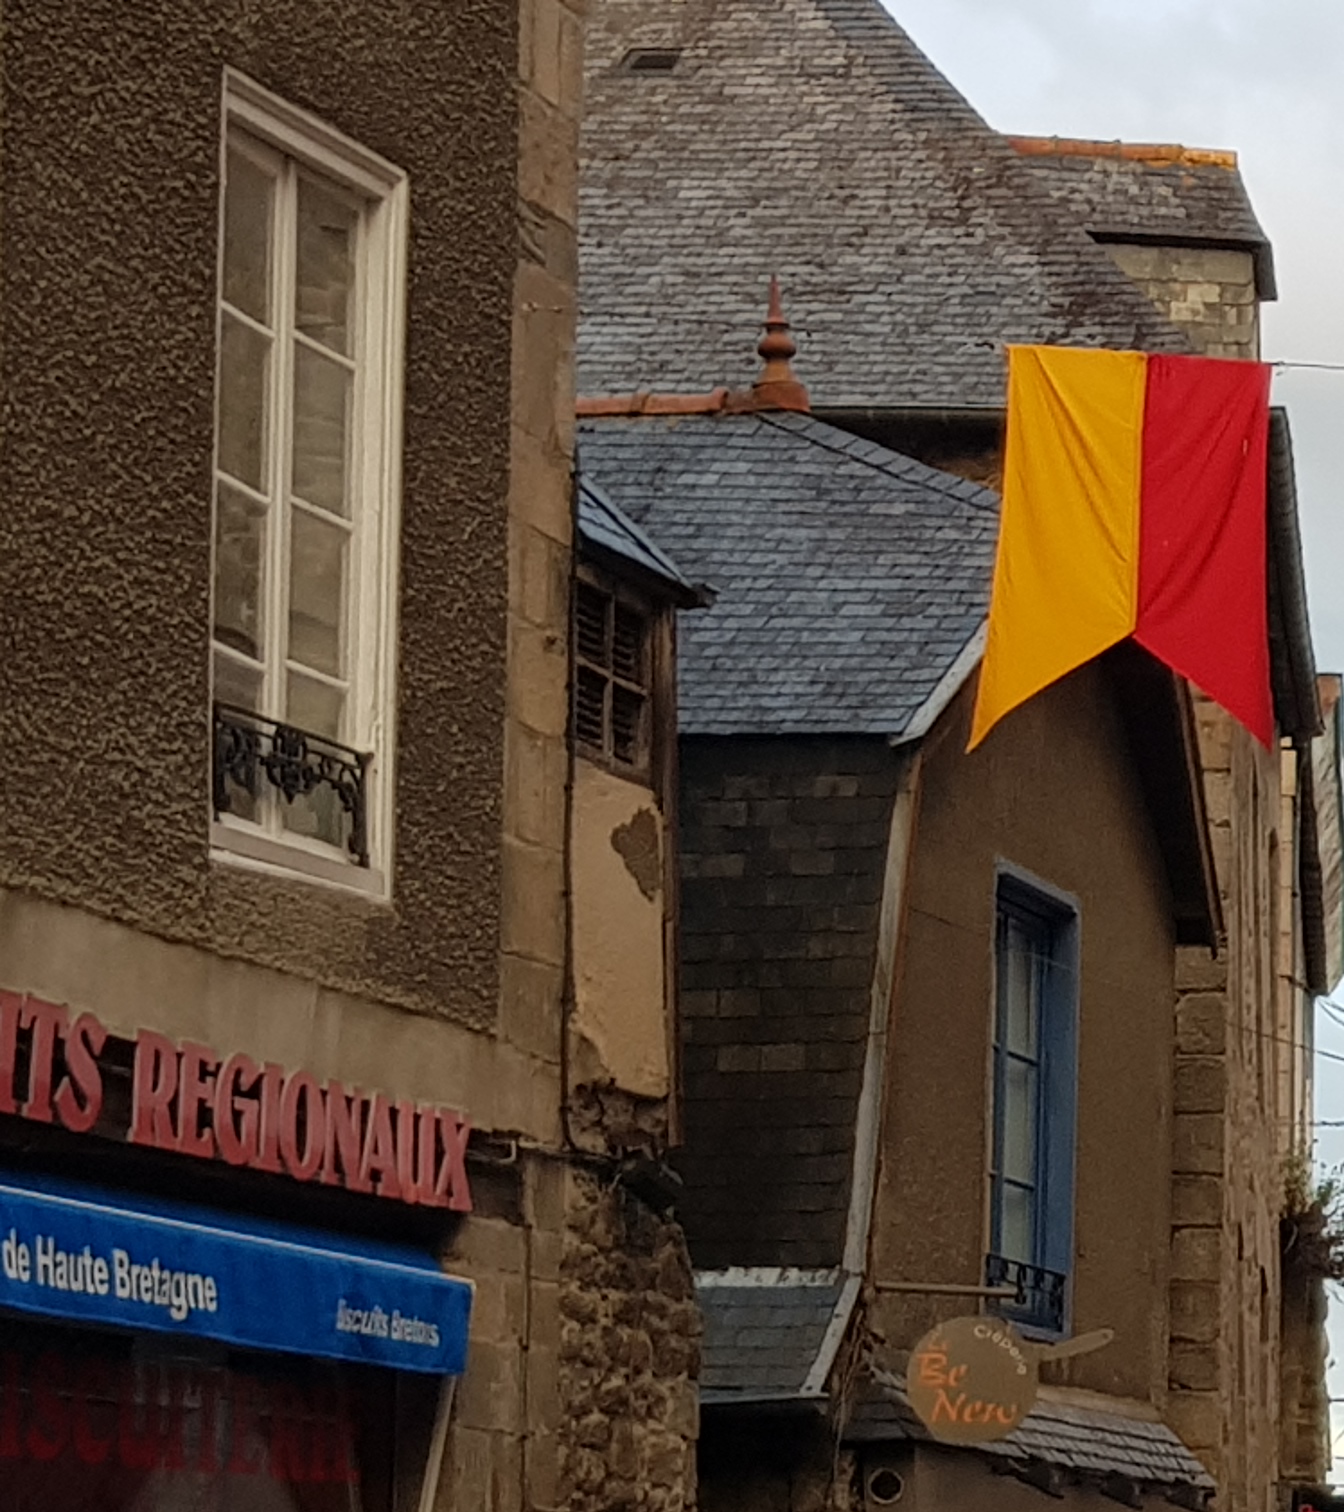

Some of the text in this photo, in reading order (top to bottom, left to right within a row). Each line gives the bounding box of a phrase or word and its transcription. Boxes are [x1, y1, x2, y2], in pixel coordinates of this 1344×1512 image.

[127, 1027, 474, 1212] REGIONAUX
[2, 1228, 218, 1322] de Haute Bretagne
